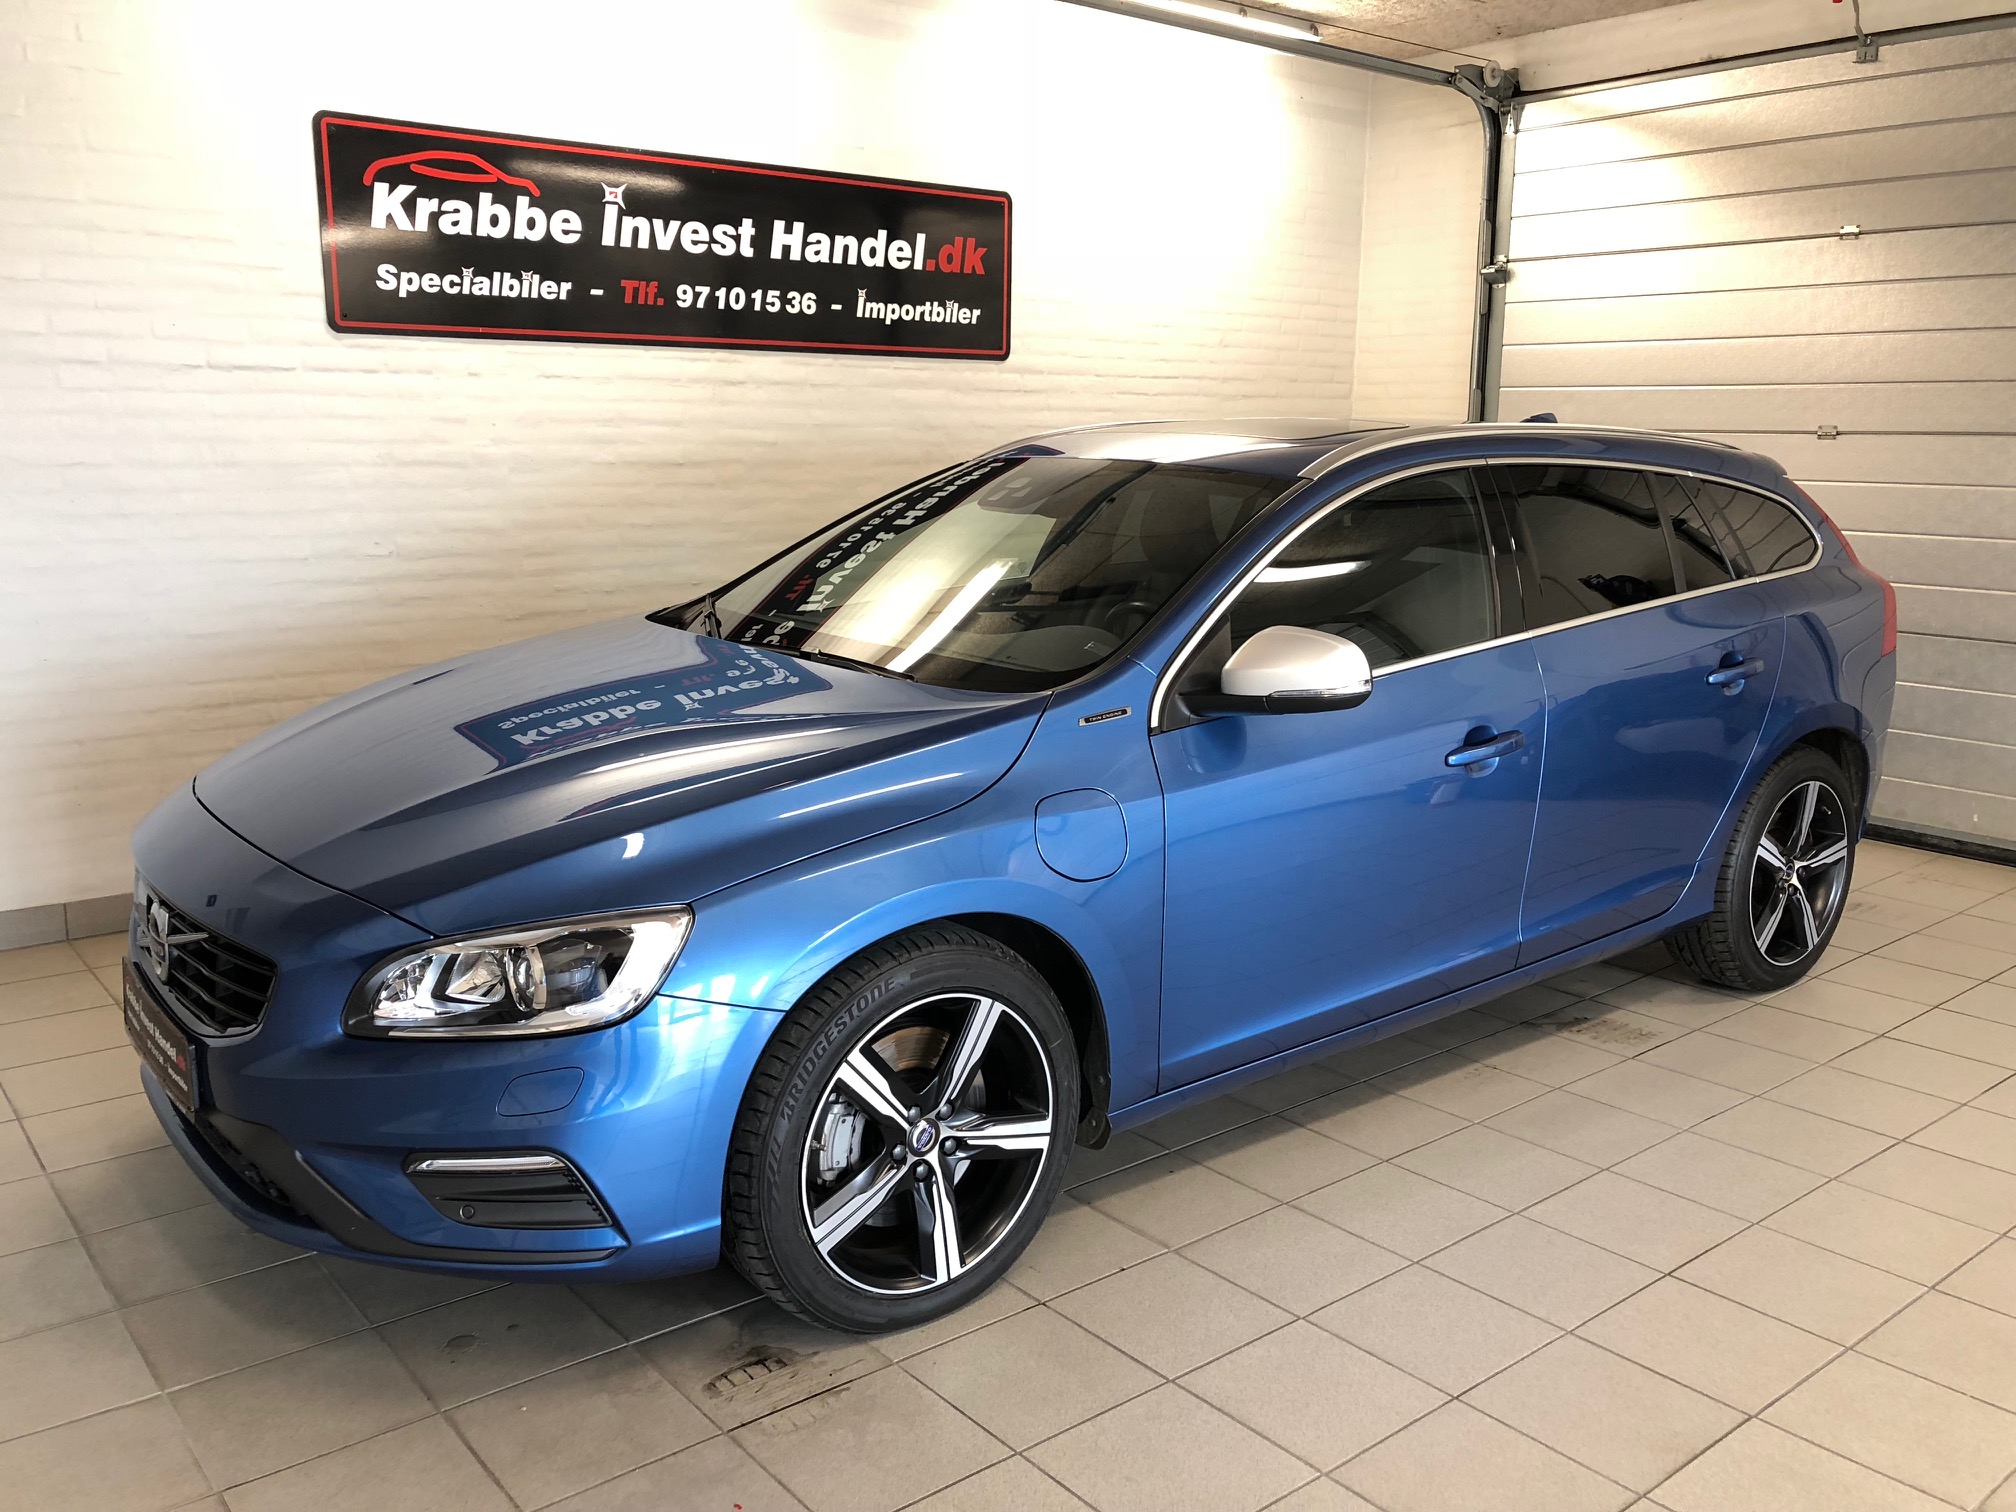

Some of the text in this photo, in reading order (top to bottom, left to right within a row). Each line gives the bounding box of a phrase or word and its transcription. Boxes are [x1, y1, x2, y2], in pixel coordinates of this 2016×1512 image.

[370, 181, 988, 275] Krabbe Invest Handel.dk
[375, 263, 572, 298] Specialbiler
[620, 279, 664, 306] Tlf.
[856, 288, 981, 325] Importbiler
[780, 976, 897, 1126] BRIDGESTONE
